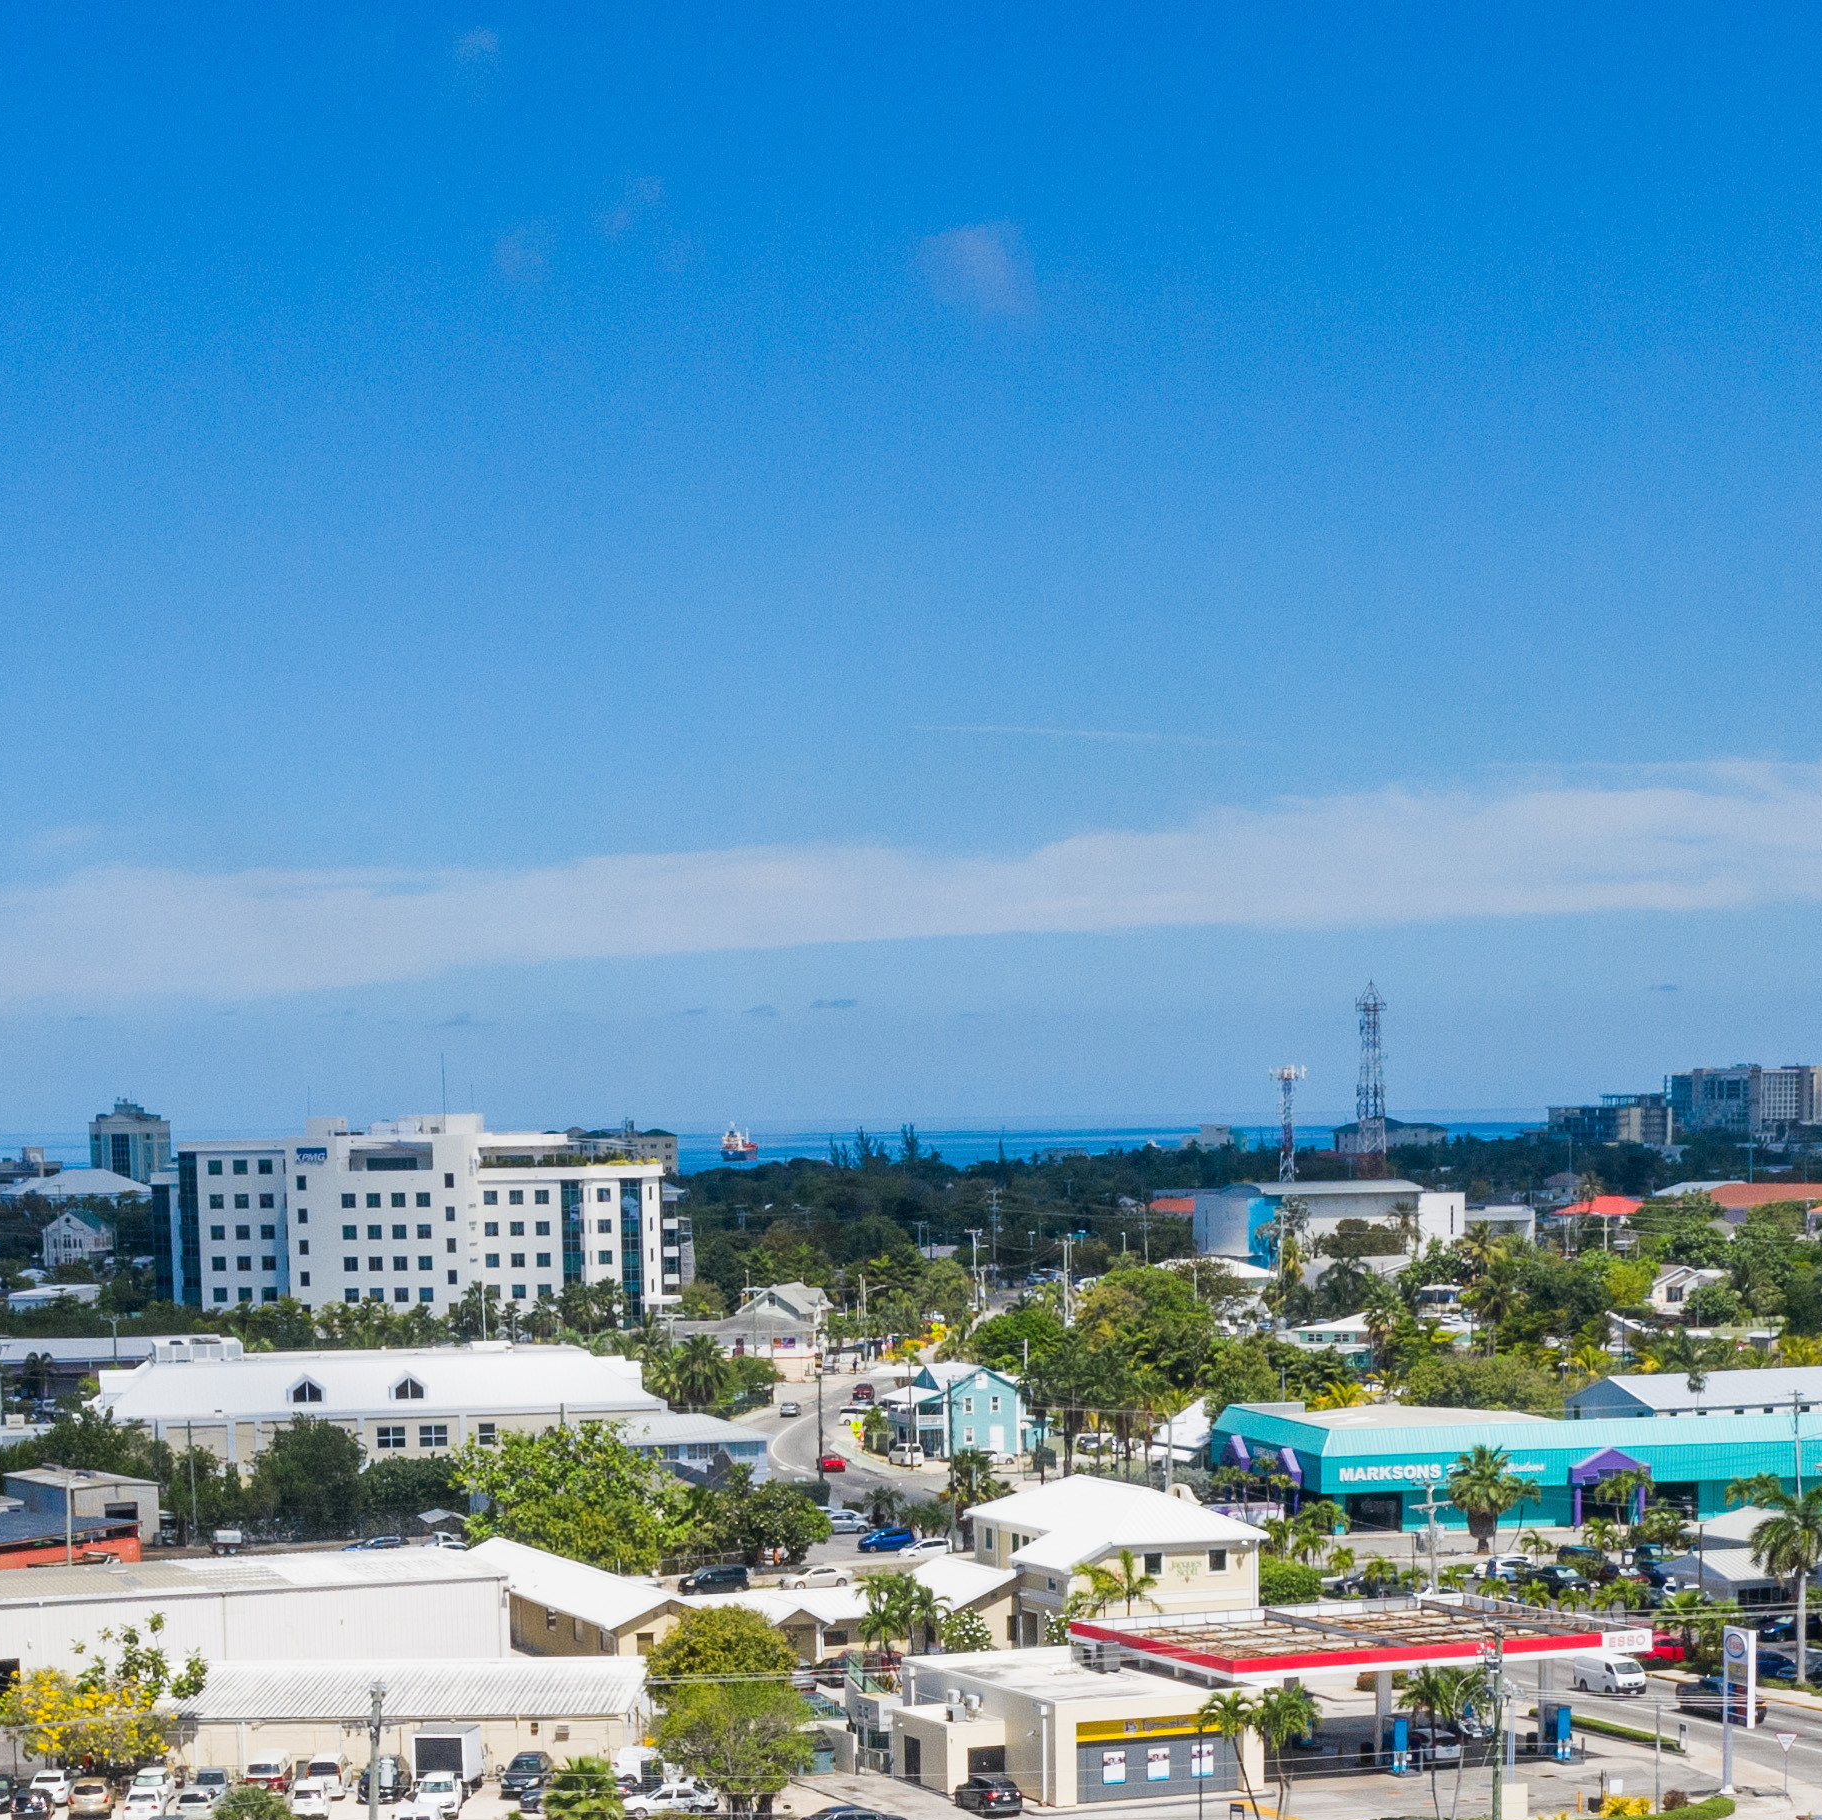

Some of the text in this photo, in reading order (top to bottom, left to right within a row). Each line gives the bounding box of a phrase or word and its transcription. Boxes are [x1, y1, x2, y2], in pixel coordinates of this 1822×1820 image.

[294, 1153, 326, 1162] KPMG
[1339, 1464, 1442, 1482] MARKSONS
[1609, 1635, 1646, 1648] ESSO
